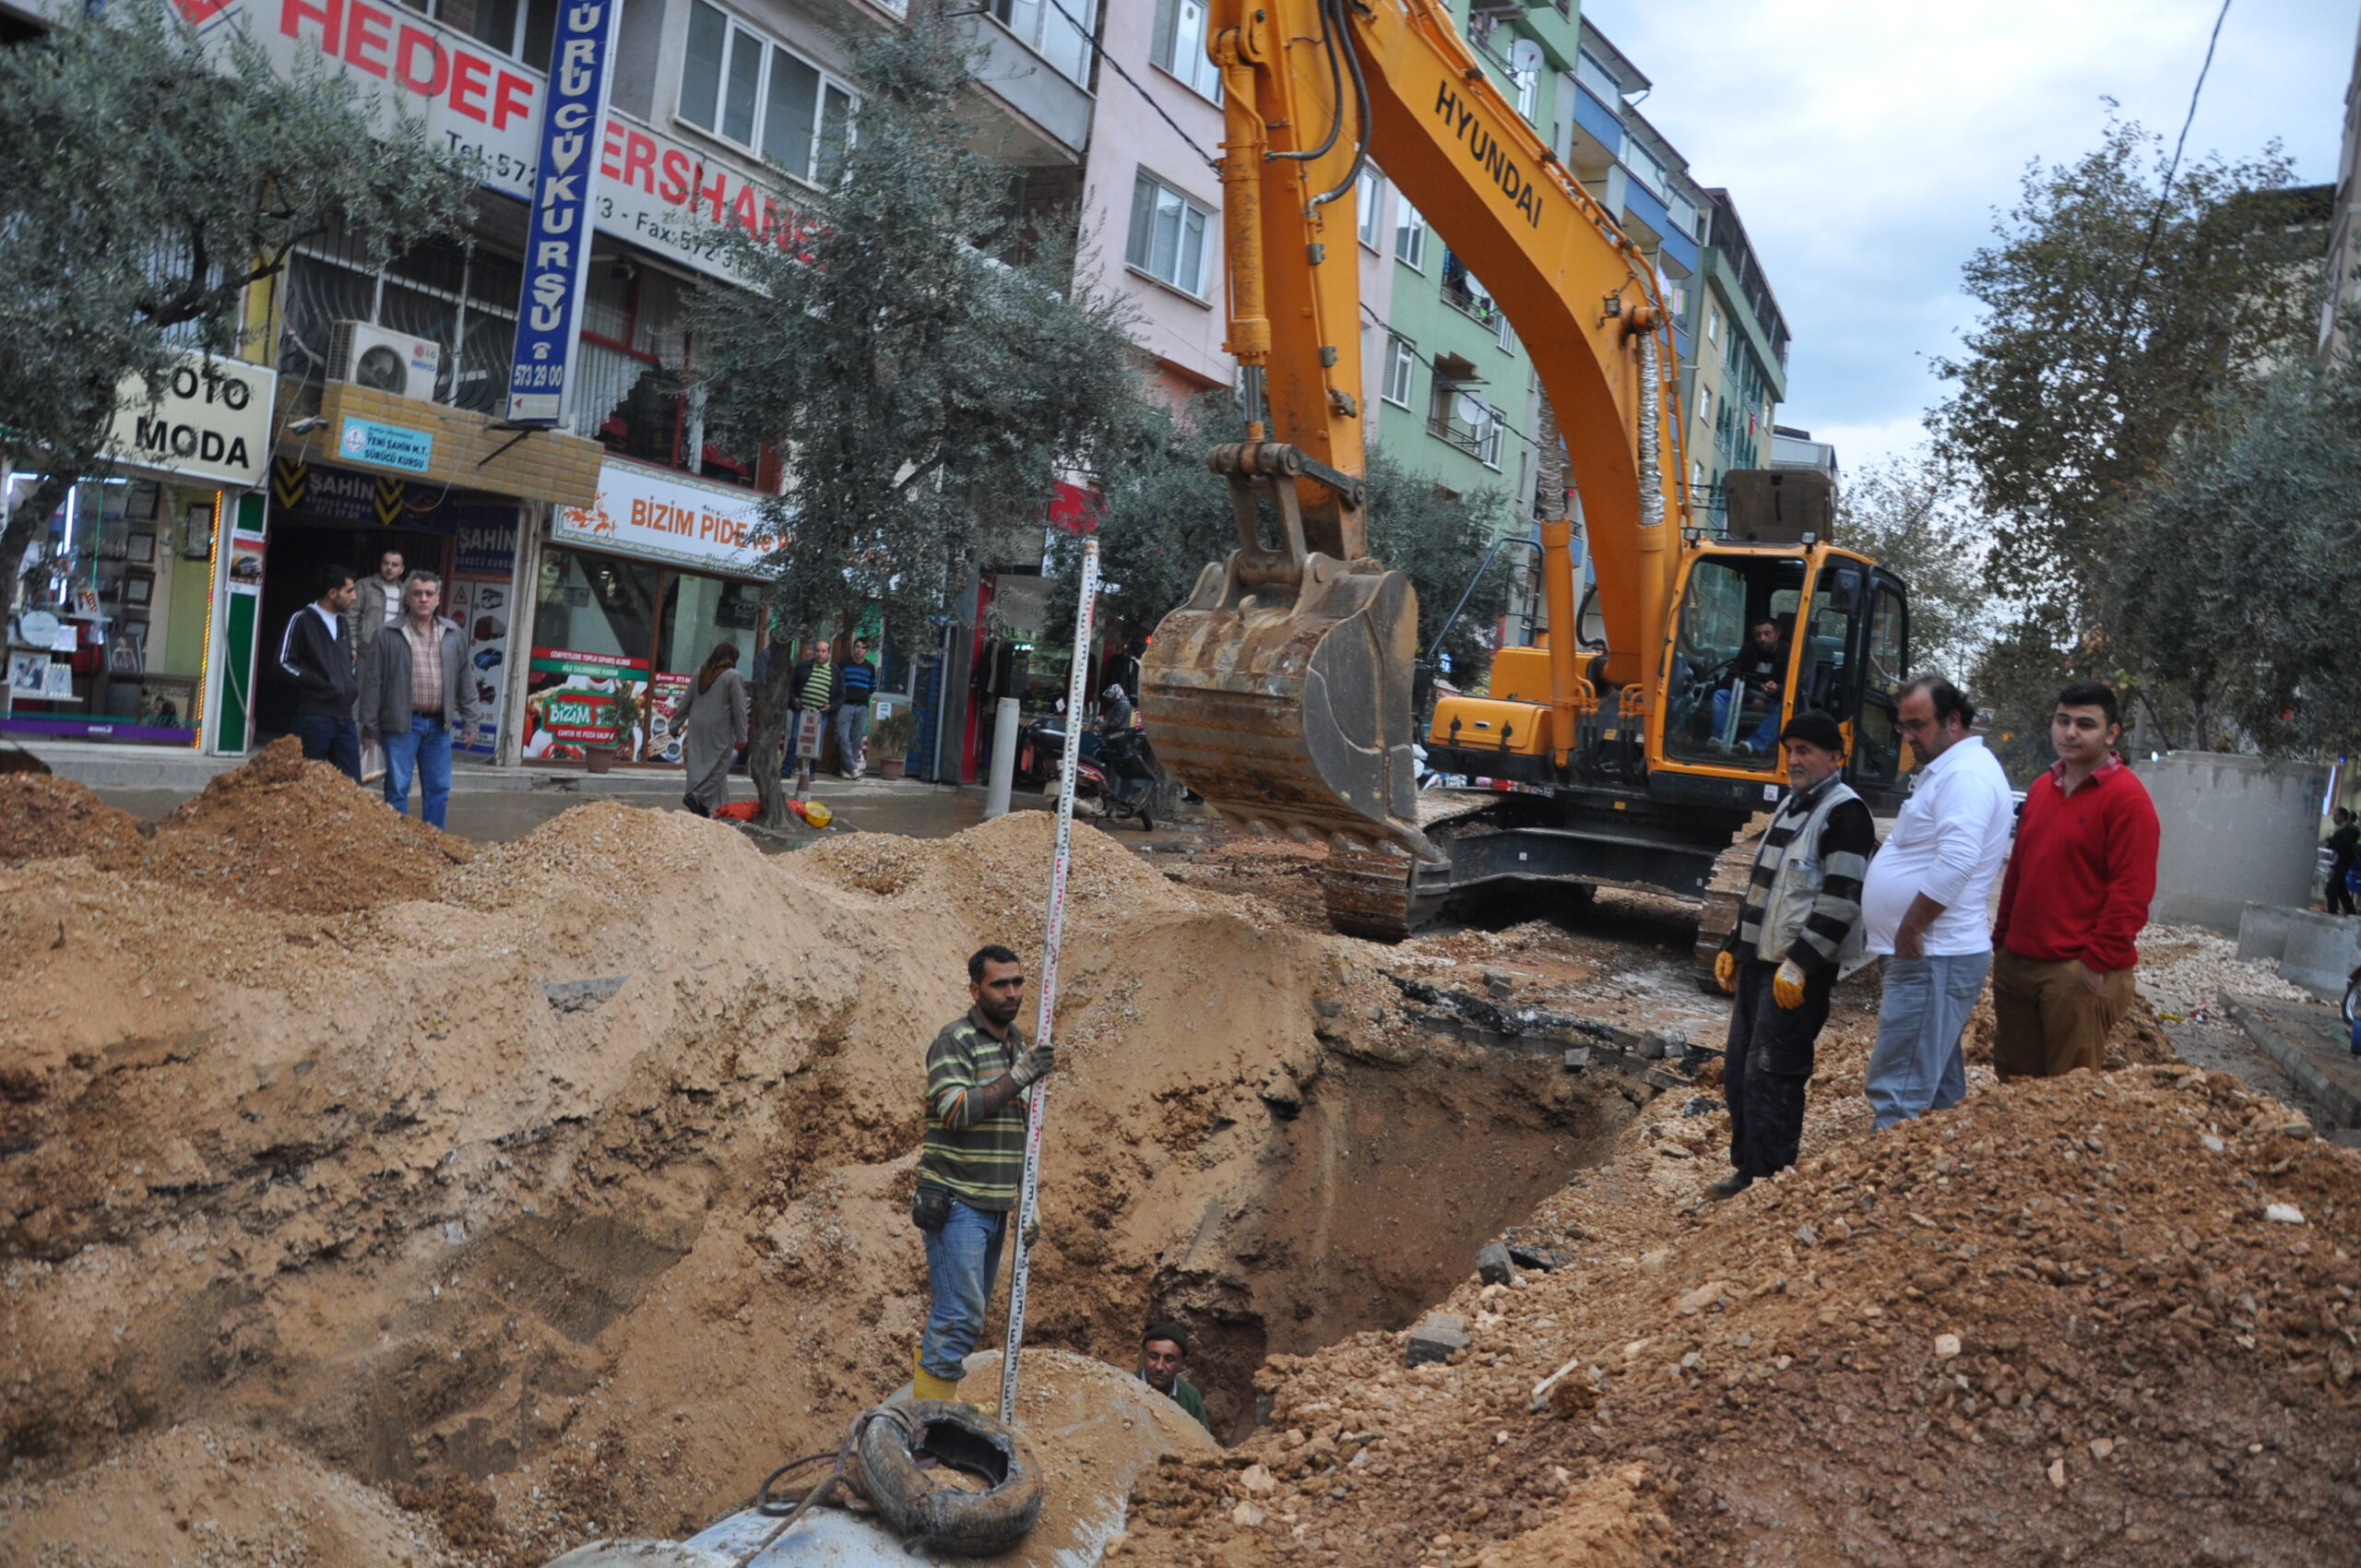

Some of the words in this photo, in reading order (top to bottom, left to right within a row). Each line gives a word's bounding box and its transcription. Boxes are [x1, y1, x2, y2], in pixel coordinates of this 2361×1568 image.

[280, 0, 534, 131] HEDEF
[552, 0, 602, 173] ÜRÜCÜ
[1435, 79, 1543, 230] HYUNDAI
[172, 366, 250, 410] OTO
[514, 364, 532, 386] 573
[533, 364, 546, 386] 29
[548, 364, 563, 386] 00
[135, 416, 250, 469] MODA
[309, 472, 375, 501] ŞAHİN
[459, 524, 517, 553] ŞAHİN
[631, 494, 693, 537] BİZİM
[700, 510, 747, 547] PİDE
